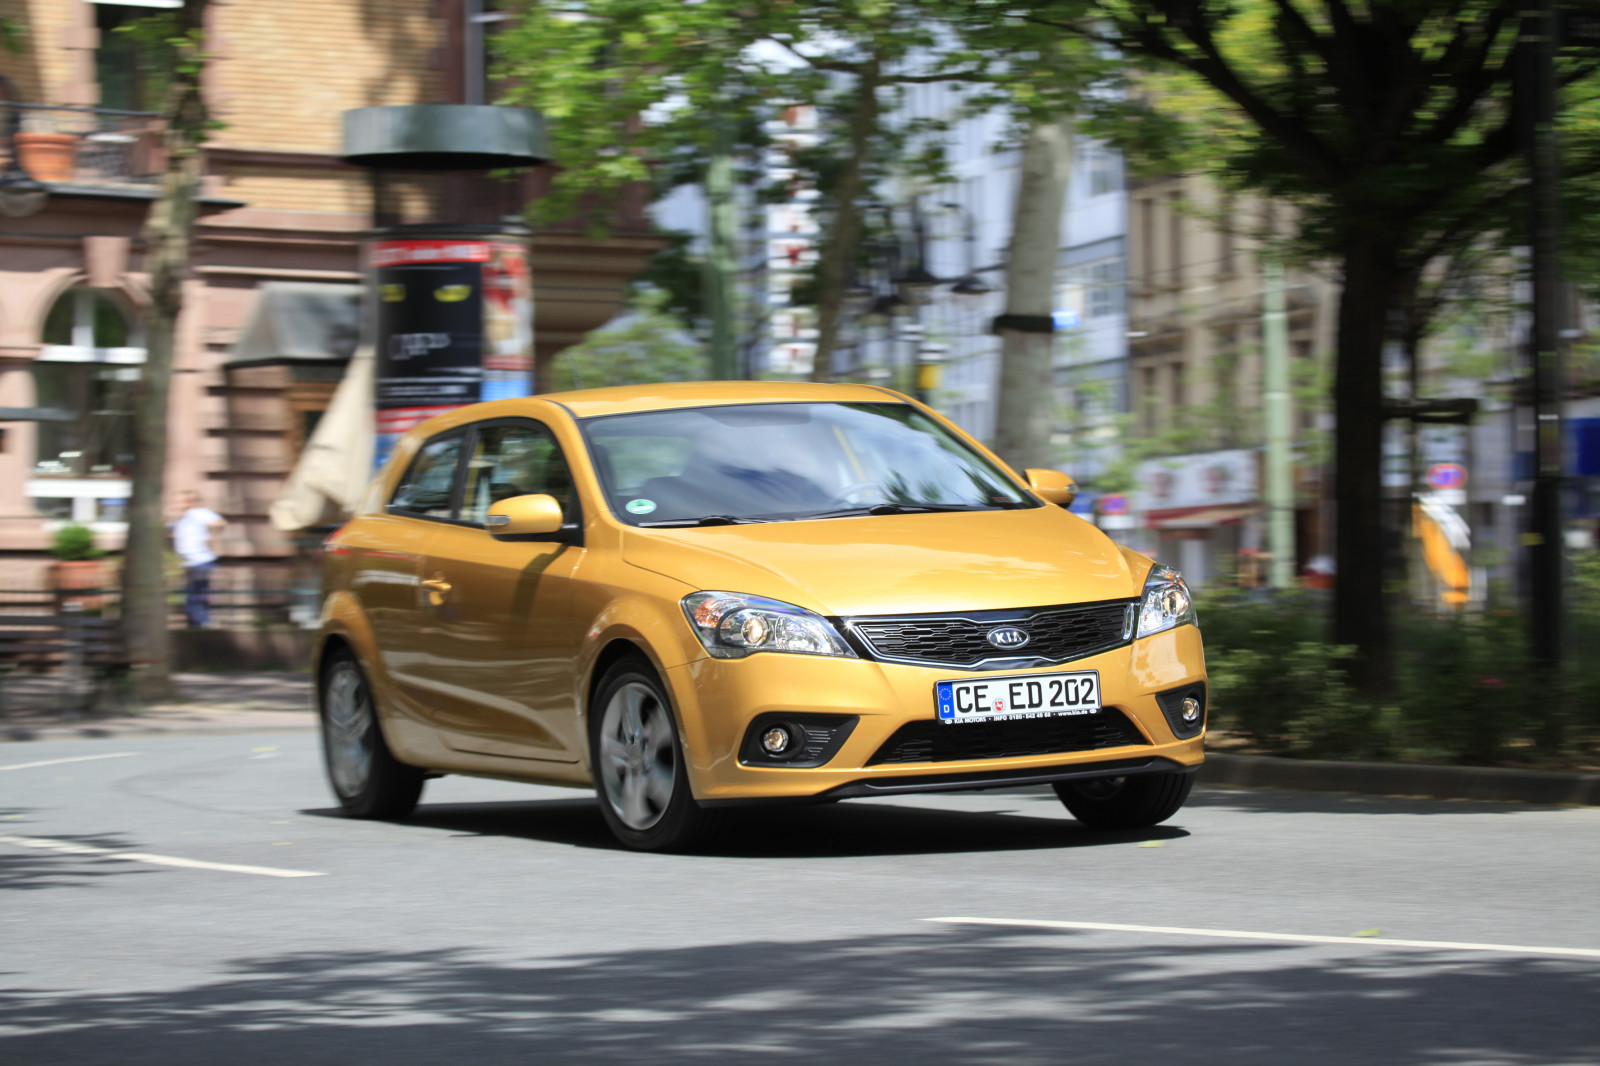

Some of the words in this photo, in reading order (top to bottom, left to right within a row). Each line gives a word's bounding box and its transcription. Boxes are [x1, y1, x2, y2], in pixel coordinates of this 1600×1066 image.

[994, 631, 1022, 643] KIA
[956, 685, 991, 713] CE
[1009, 681, 1043, 710] ED
[1049, 678, 1096, 707] 202
[943, 704, 950, 713] D
